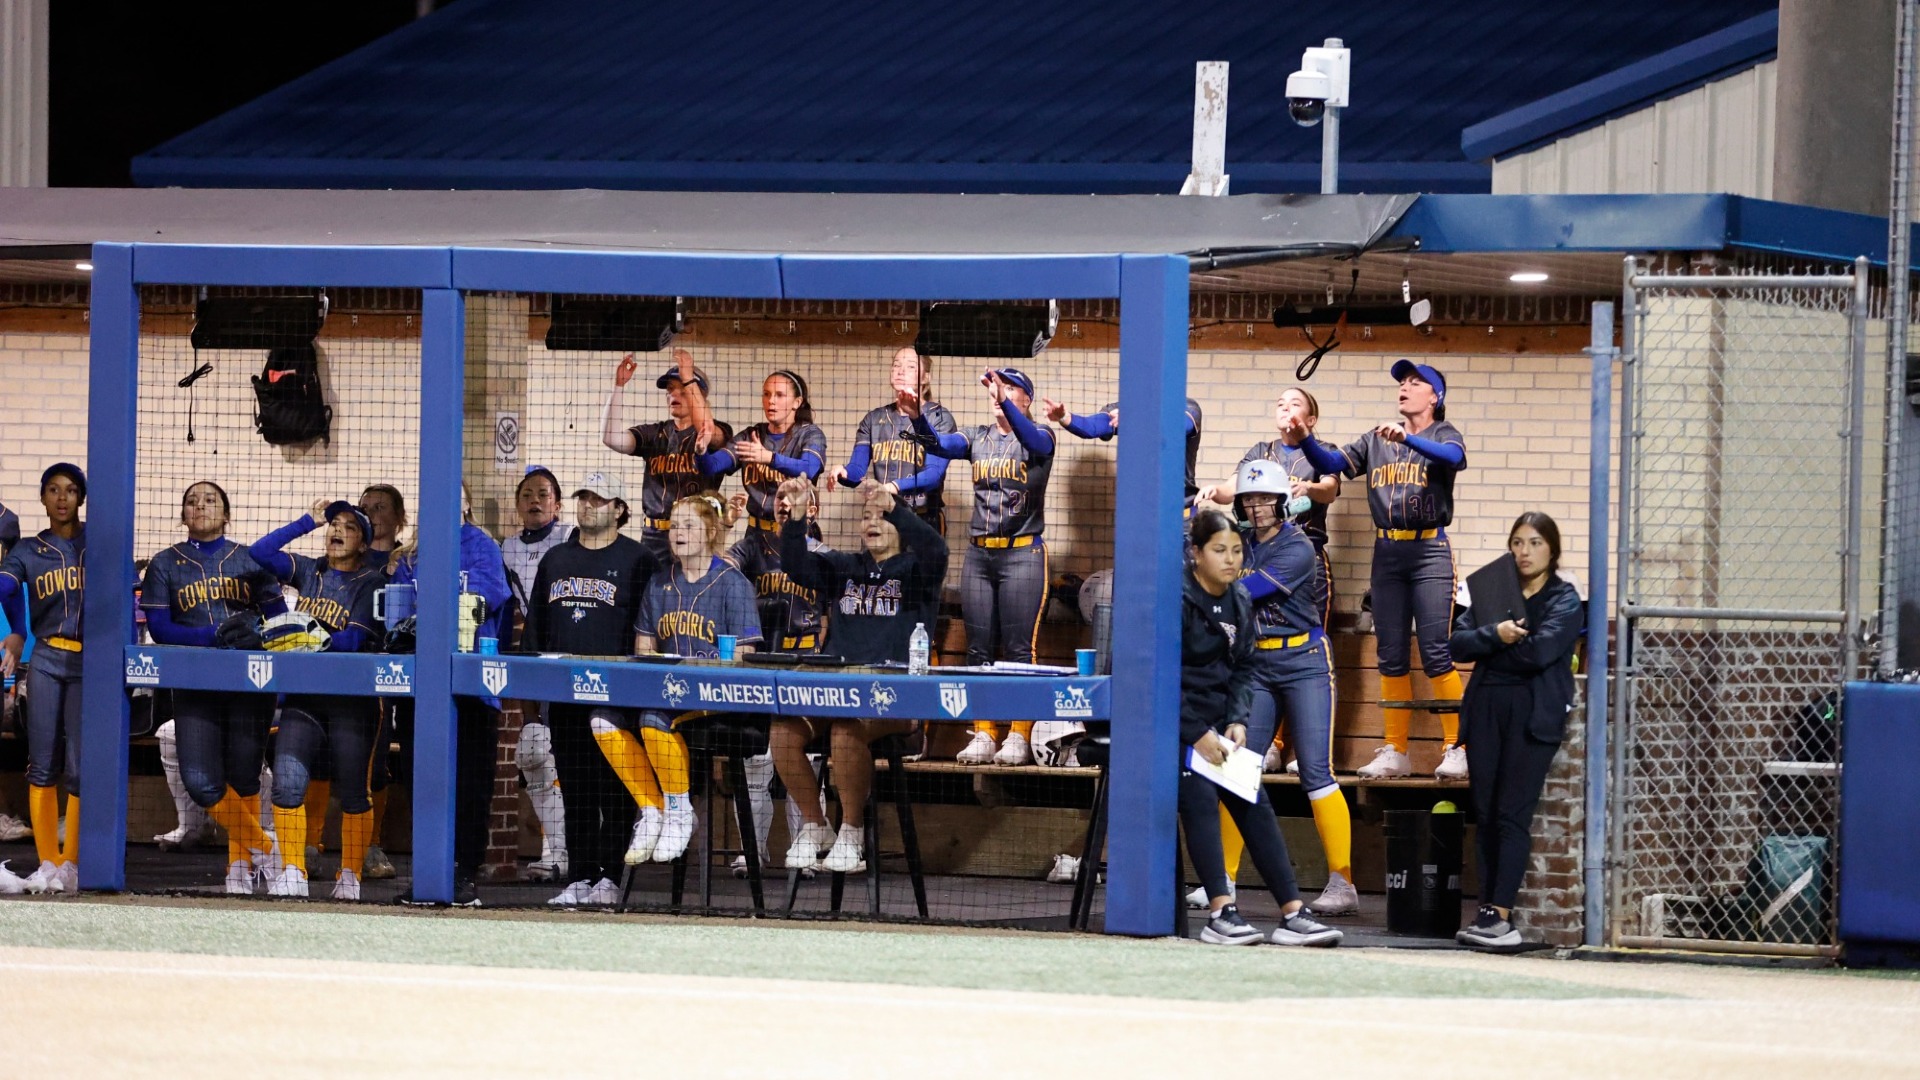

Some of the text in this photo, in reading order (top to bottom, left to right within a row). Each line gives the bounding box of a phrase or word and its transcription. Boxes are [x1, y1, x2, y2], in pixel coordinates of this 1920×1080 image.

[871, 439, 925, 467] OWGIRLS
[972, 458, 1028, 484] OWGIRLS
[1371, 462, 1429, 489] COWGIRLS
[1008, 490, 1029, 517] 21
[1408, 494, 1437, 521] 34
[178, 577, 251, 612] COWGIRLS
[561, 600, 599, 608] SOFTBALL
[658, 611, 716, 644] COWGIRLS
[801, 610, 814, 627] 5
[698, 682, 861, 708] McNEESE COWGIRLS
